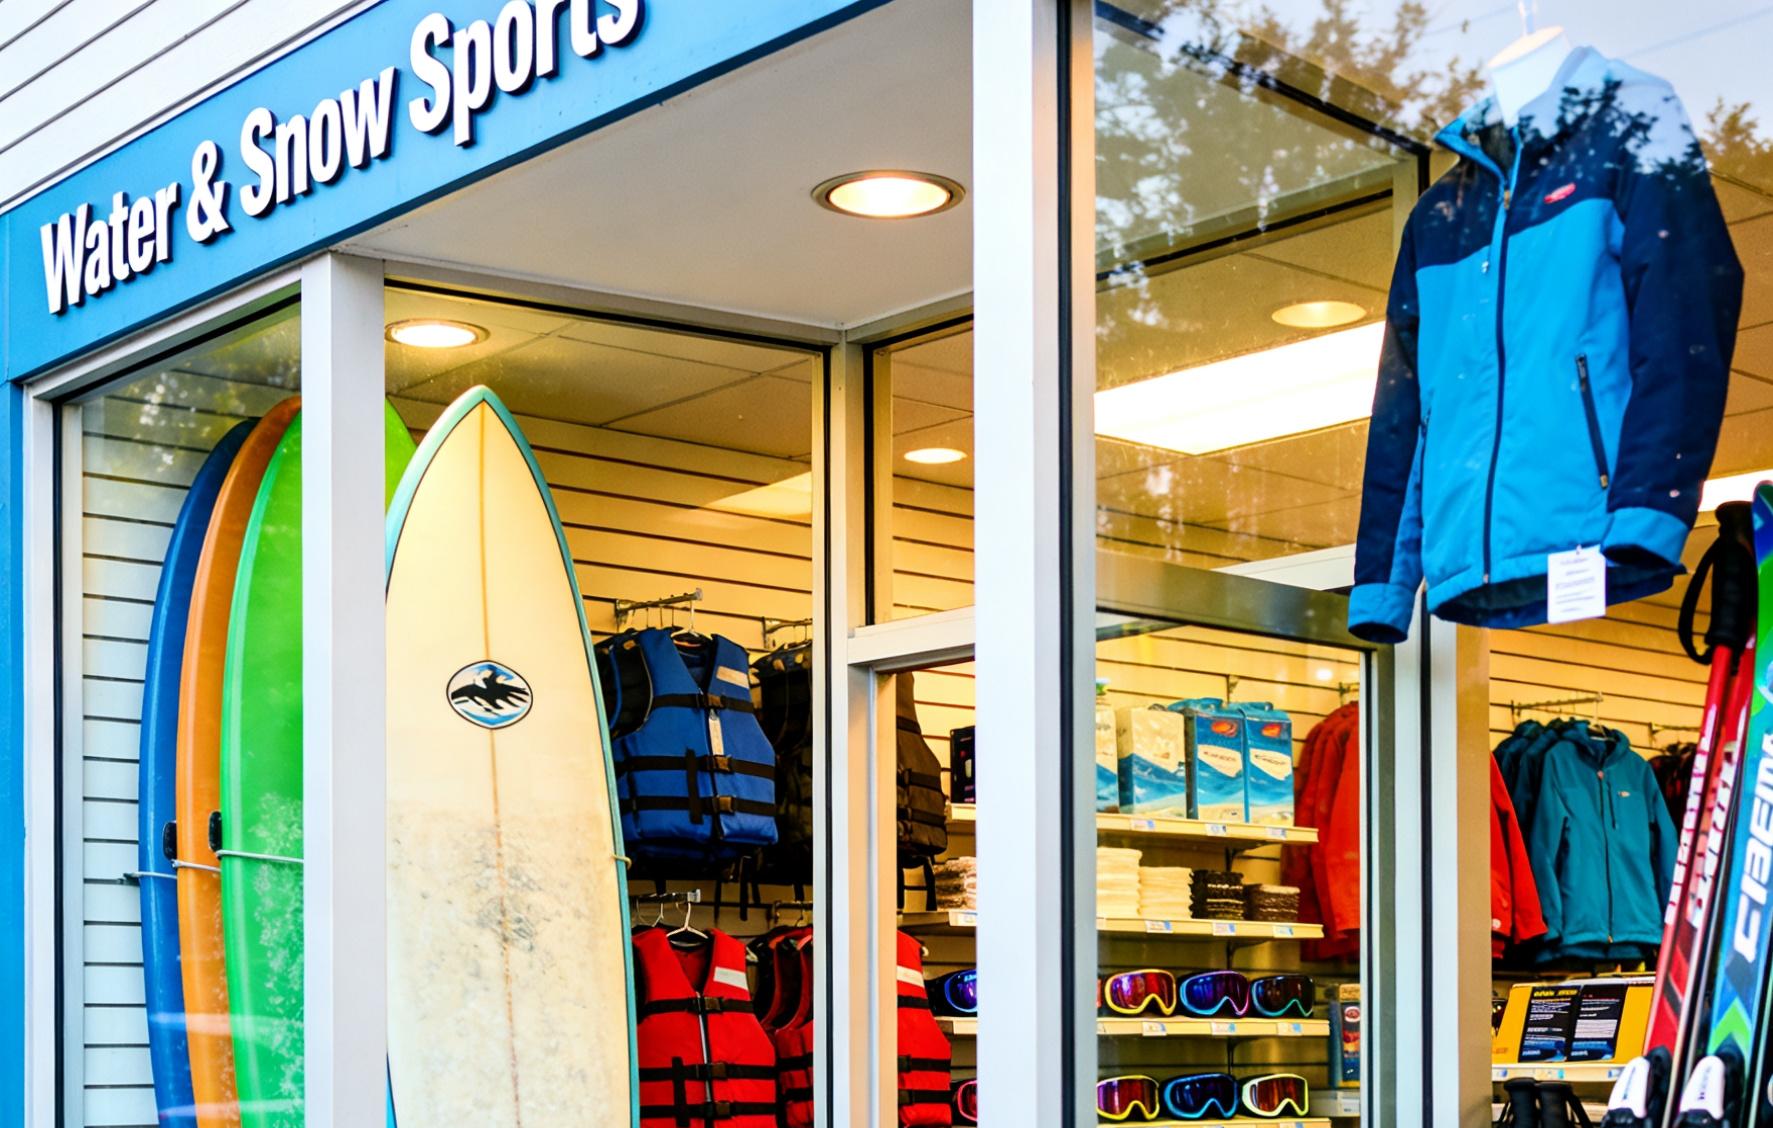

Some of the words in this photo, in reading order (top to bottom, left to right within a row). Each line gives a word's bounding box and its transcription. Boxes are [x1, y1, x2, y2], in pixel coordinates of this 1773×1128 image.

[41, 181, 179, 315] Water
[186, 140, 229, 243] &
[240, 66, 396, 217] Snow
